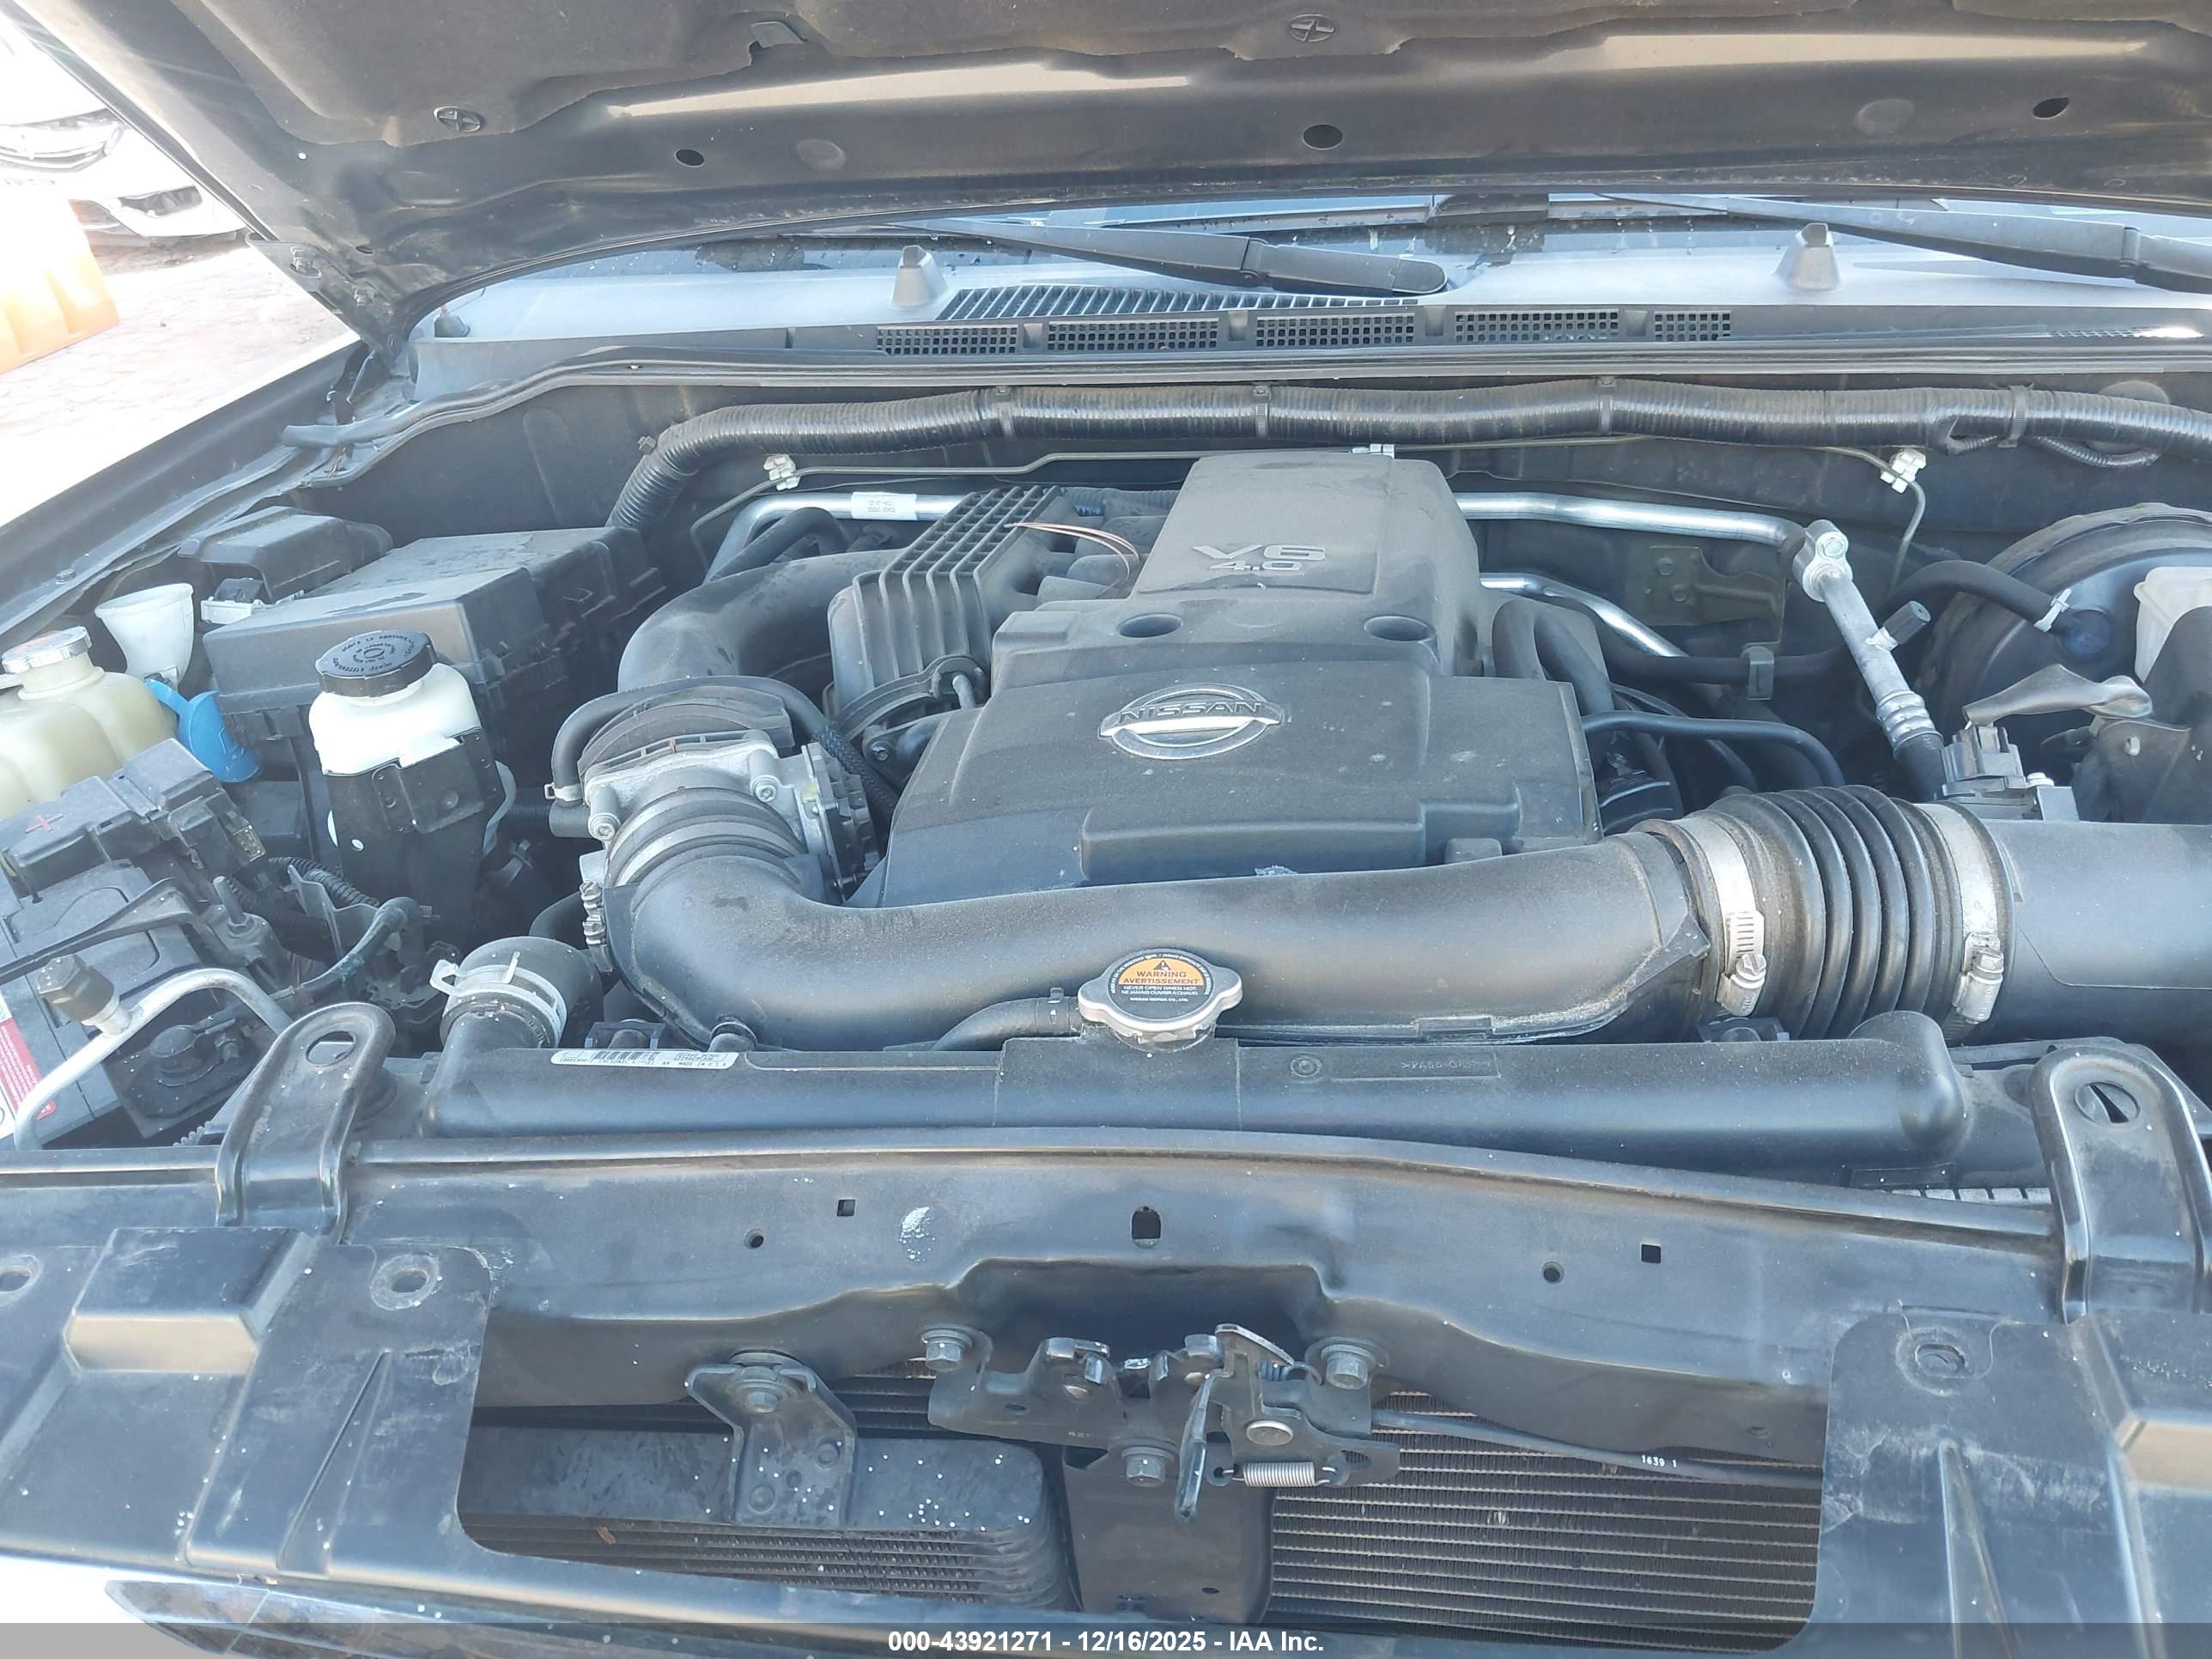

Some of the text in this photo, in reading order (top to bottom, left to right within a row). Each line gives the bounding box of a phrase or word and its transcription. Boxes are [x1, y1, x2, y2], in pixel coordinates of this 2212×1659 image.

[1192, 544, 1326, 561] V6
[1209, 561, 1303, 570] 4.0
[1120, 702, 1261, 723] NISSAN
[1641, 1453, 1677, 1468] 1639 1
